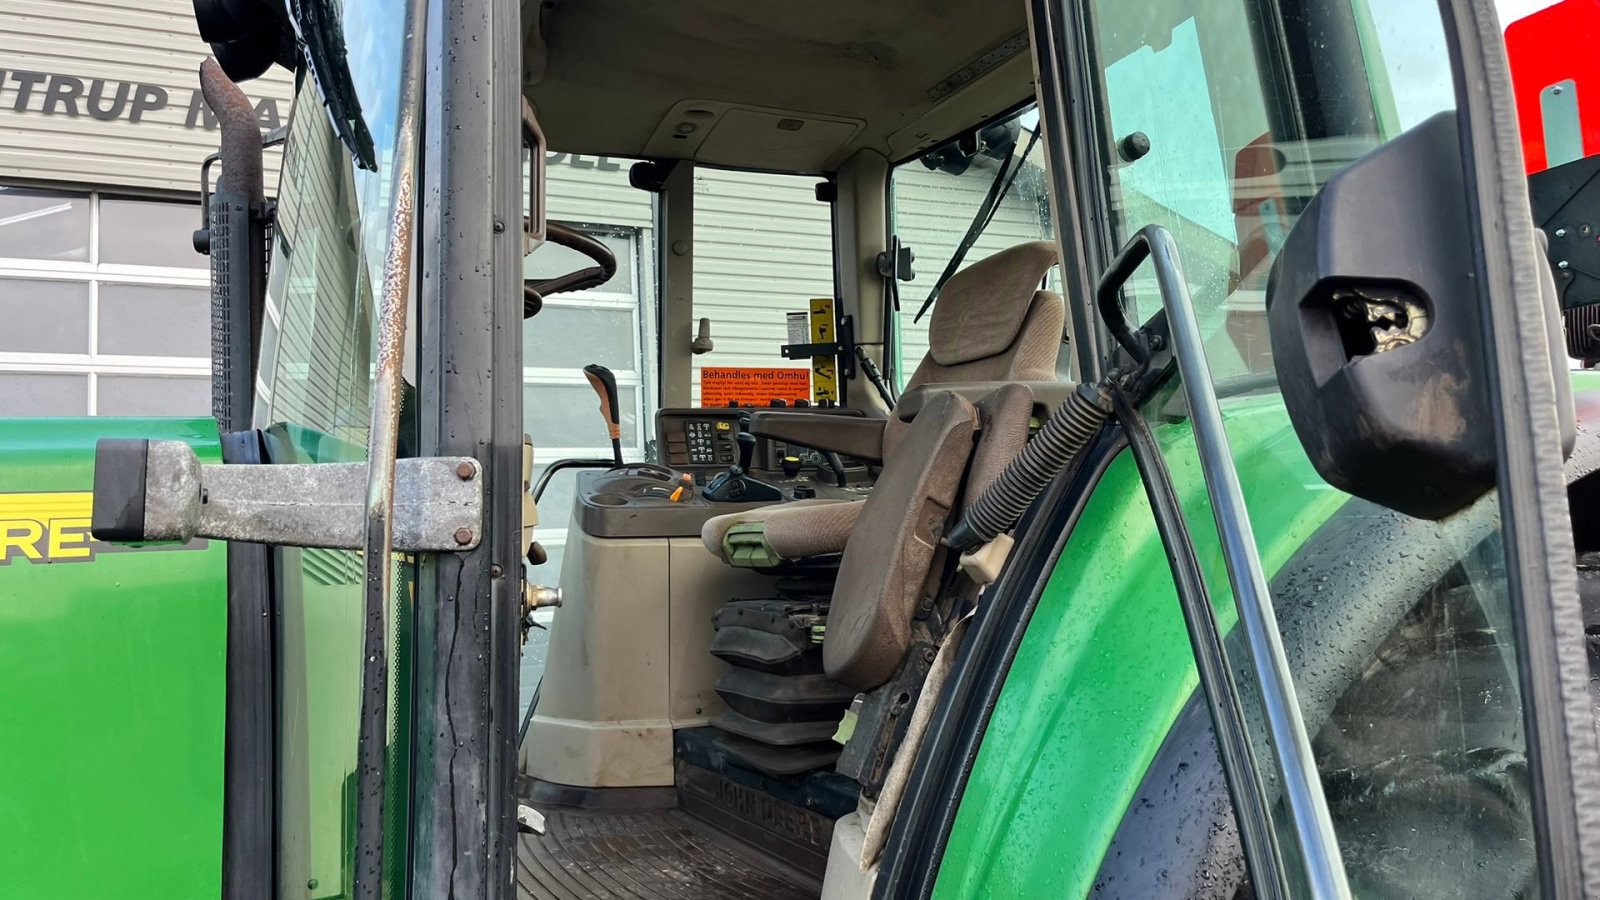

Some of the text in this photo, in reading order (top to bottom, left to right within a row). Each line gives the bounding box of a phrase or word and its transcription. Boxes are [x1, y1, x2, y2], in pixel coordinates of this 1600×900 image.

[0, 70, 168, 123] TRUP
[703, 370, 809, 380] Behandles med Omhu!
